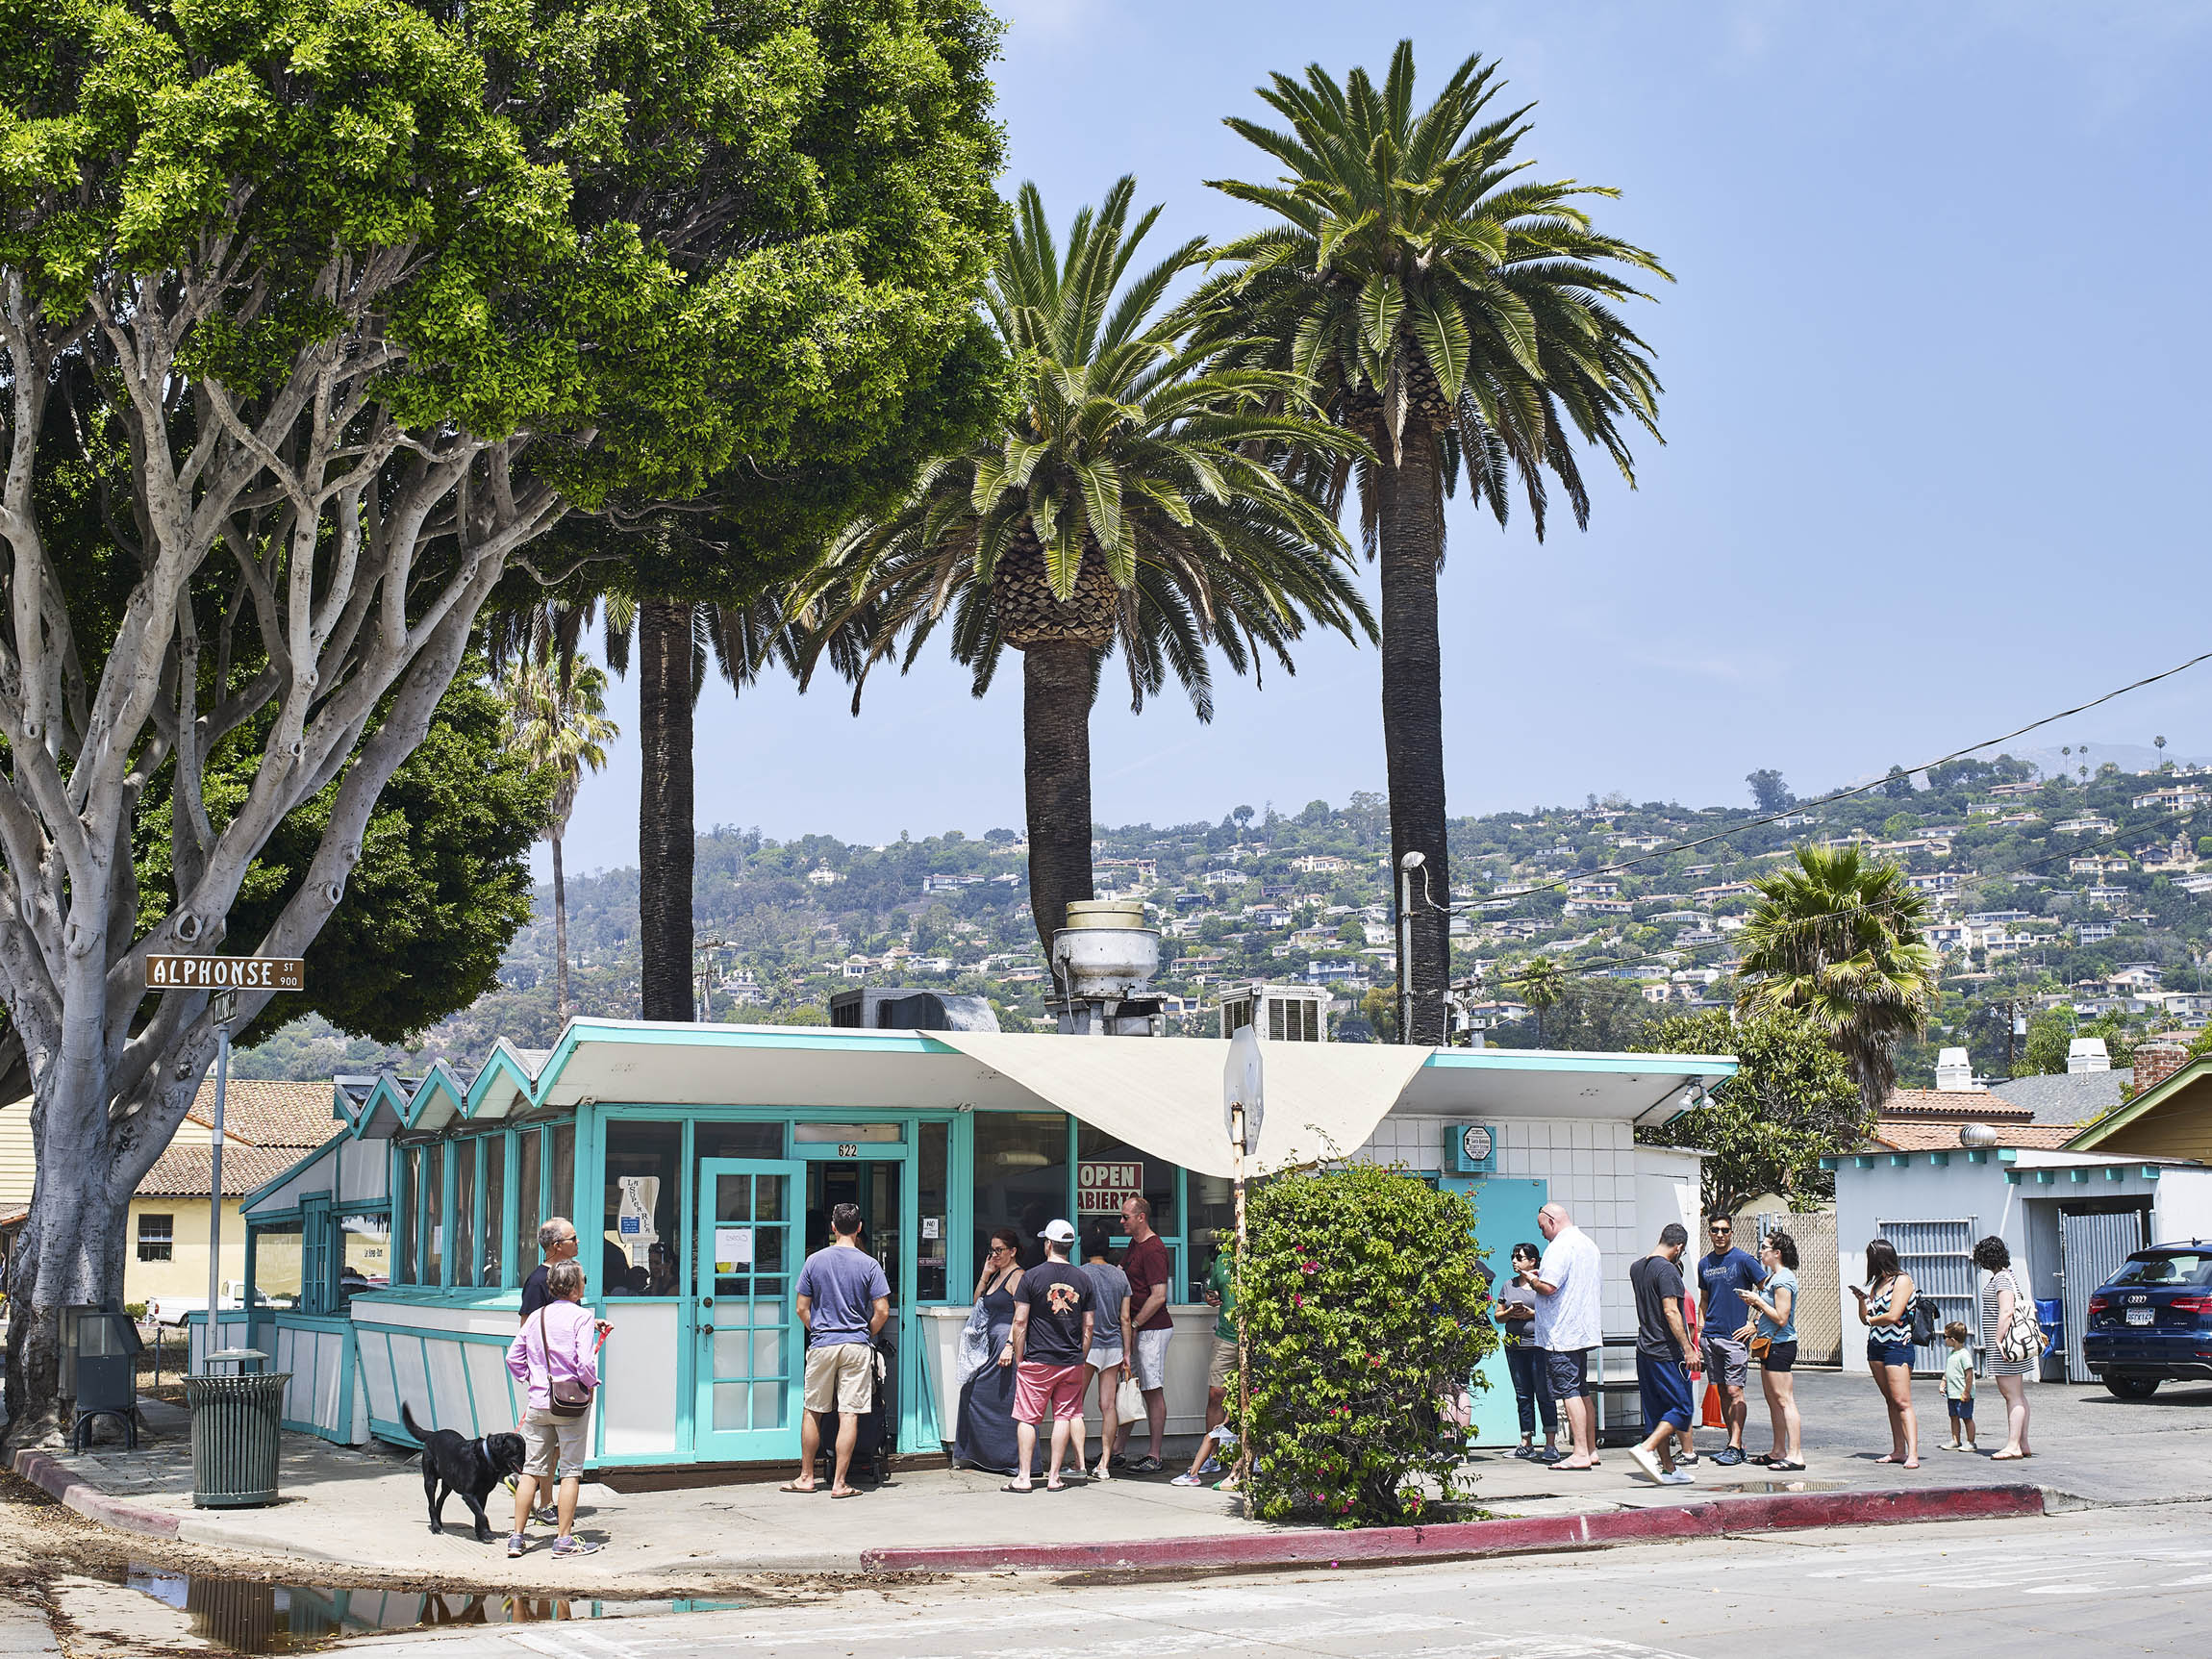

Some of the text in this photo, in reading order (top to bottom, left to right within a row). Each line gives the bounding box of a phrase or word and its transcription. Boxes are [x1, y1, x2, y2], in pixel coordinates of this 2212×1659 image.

[154, 960, 273, 986] ALPHONSE
[284, 963, 294, 972] ST
[280, 977, 297, 986] 900
[838, 1144, 858, 1157] 622
[1080, 1165, 1135, 1187] OPEN
